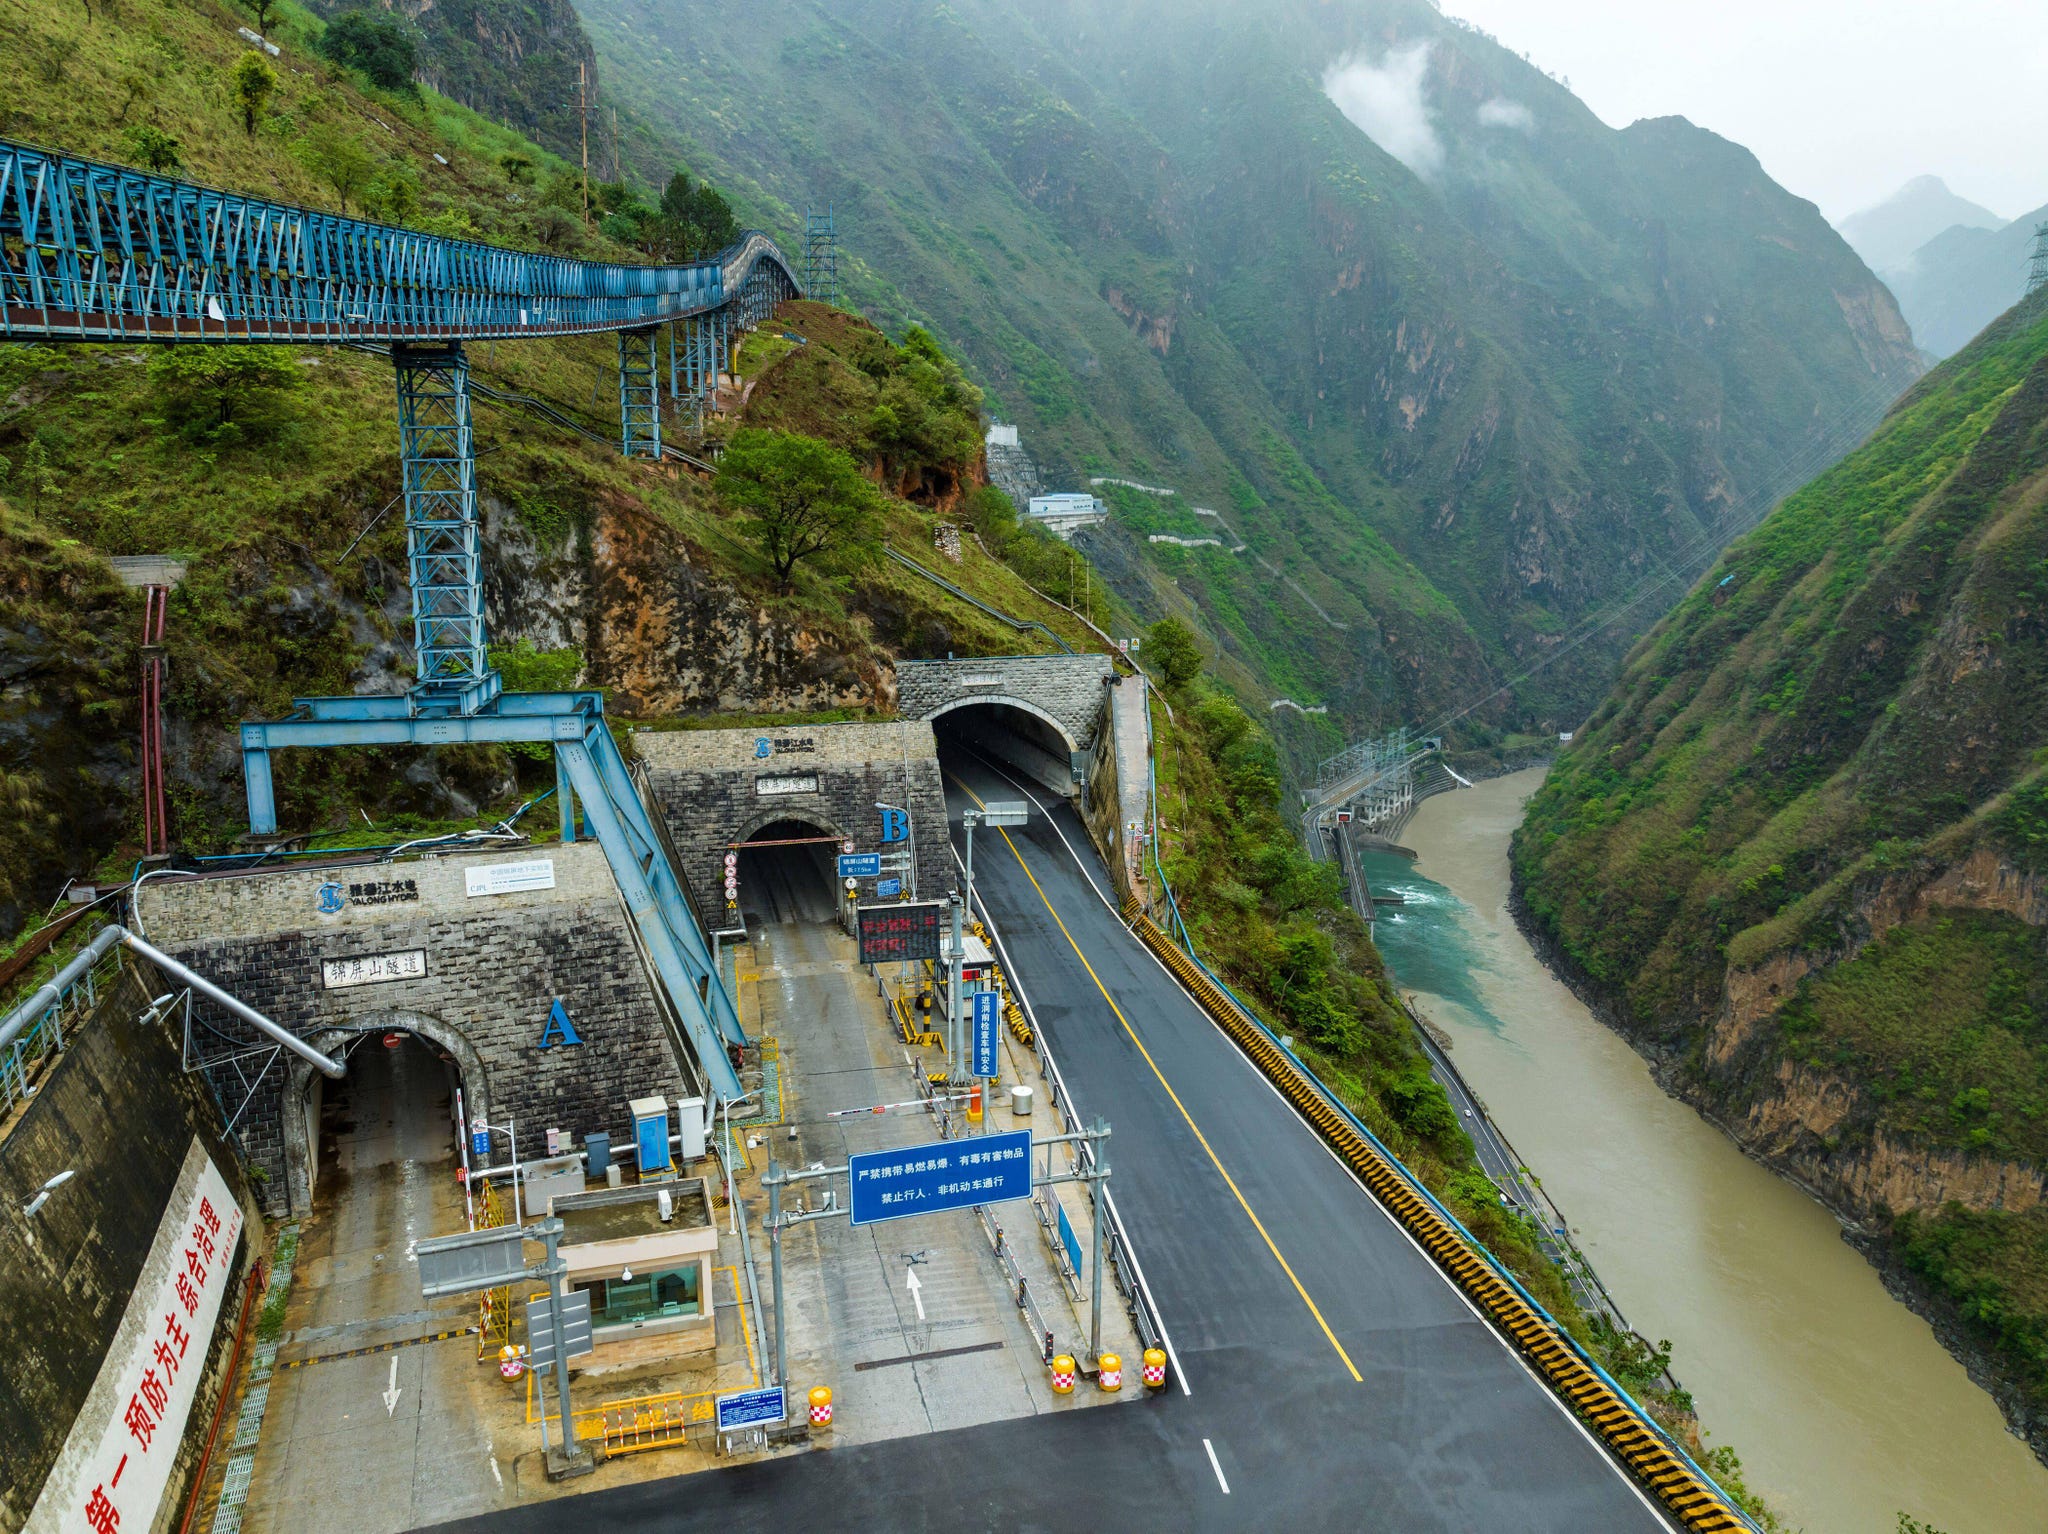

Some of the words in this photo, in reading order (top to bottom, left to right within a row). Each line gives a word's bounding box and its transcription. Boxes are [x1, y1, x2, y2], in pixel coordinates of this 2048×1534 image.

[880, 809, 909, 843] B
[349, 895, 387, 906] YALONG
[387, 892, 419, 903] HYDRO
[331, 955, 421, 983] 锦屏山隧道
[536, 997, 584, 1049] A
[980, 995, 991, 1074] 进洞前检查车辆安全
[84, 1453, 129, 1534] 第一
[124, 1311, 190, 1454] 预防为主
[175, 1195, 221, 1319] 综合治理
